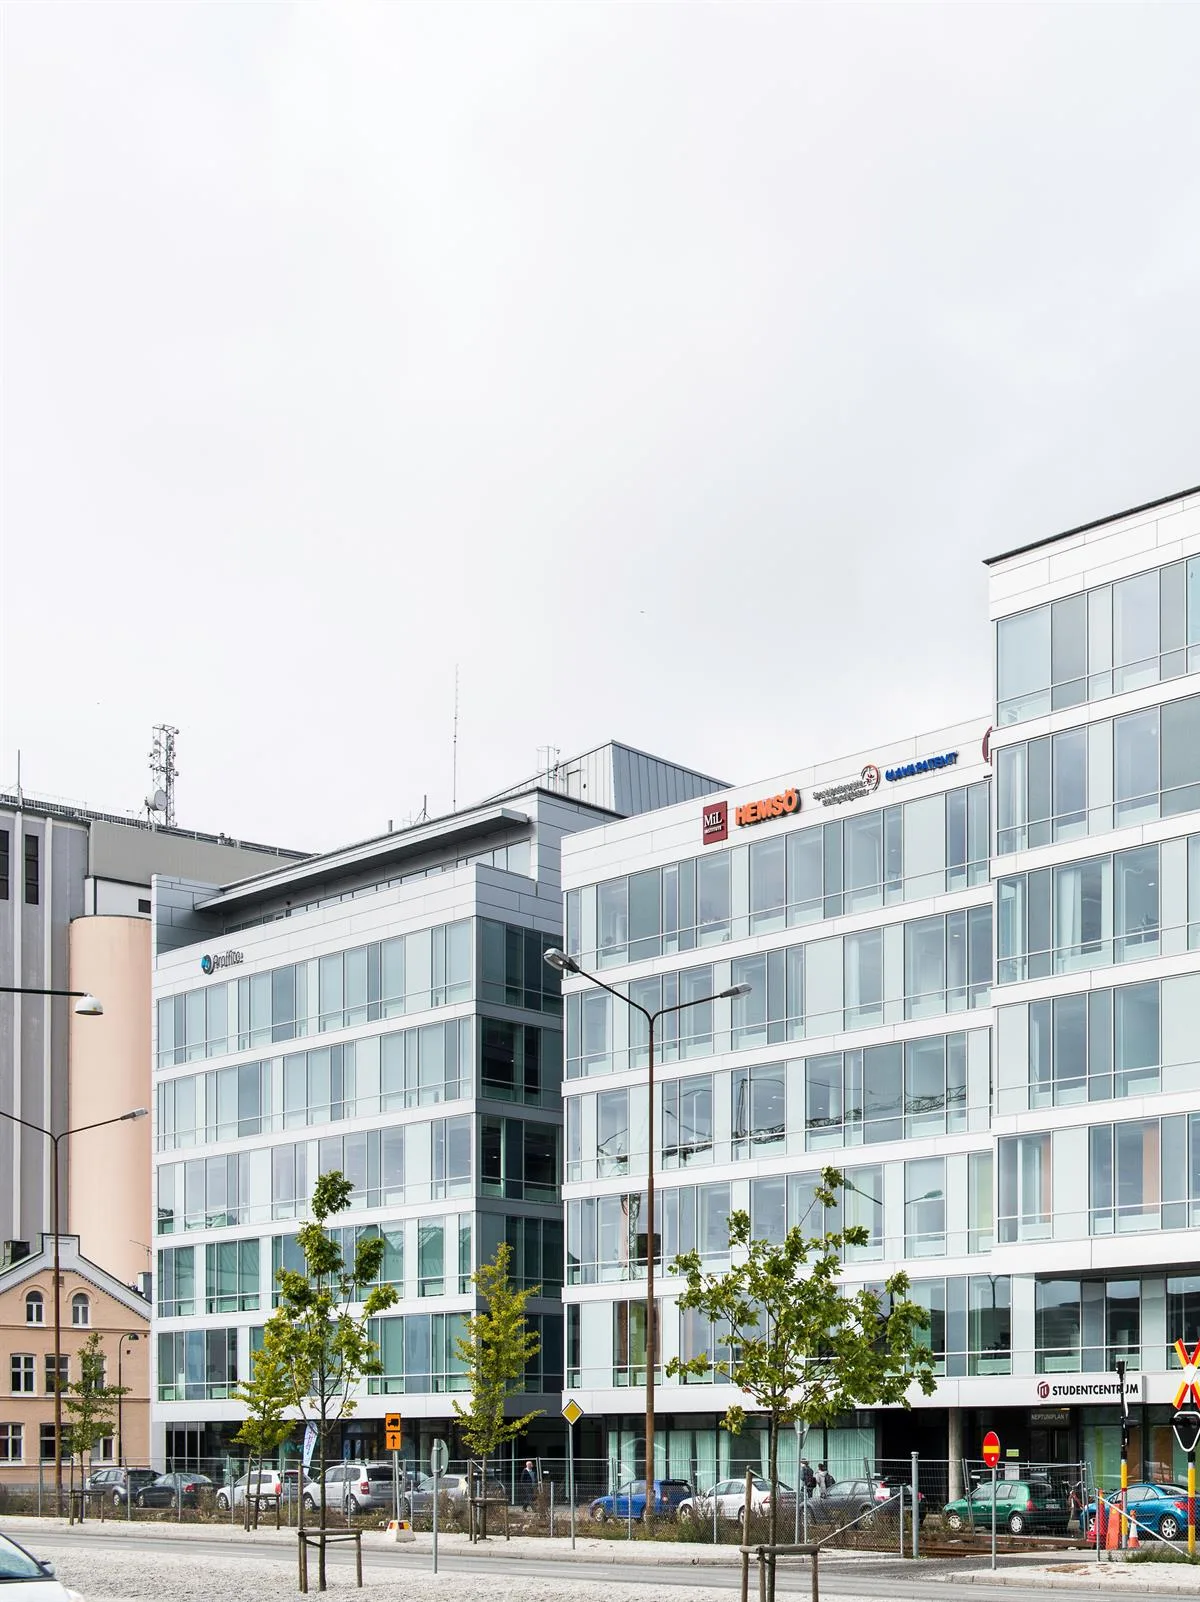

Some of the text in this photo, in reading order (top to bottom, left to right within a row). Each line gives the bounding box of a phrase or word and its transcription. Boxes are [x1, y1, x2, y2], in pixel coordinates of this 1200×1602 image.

[735, 787, 798, 827] HEMSÖ
[704, 811, 723, 828] MiL
[1052, 1384, 1139, 1396] STUDENTCENTRUM
